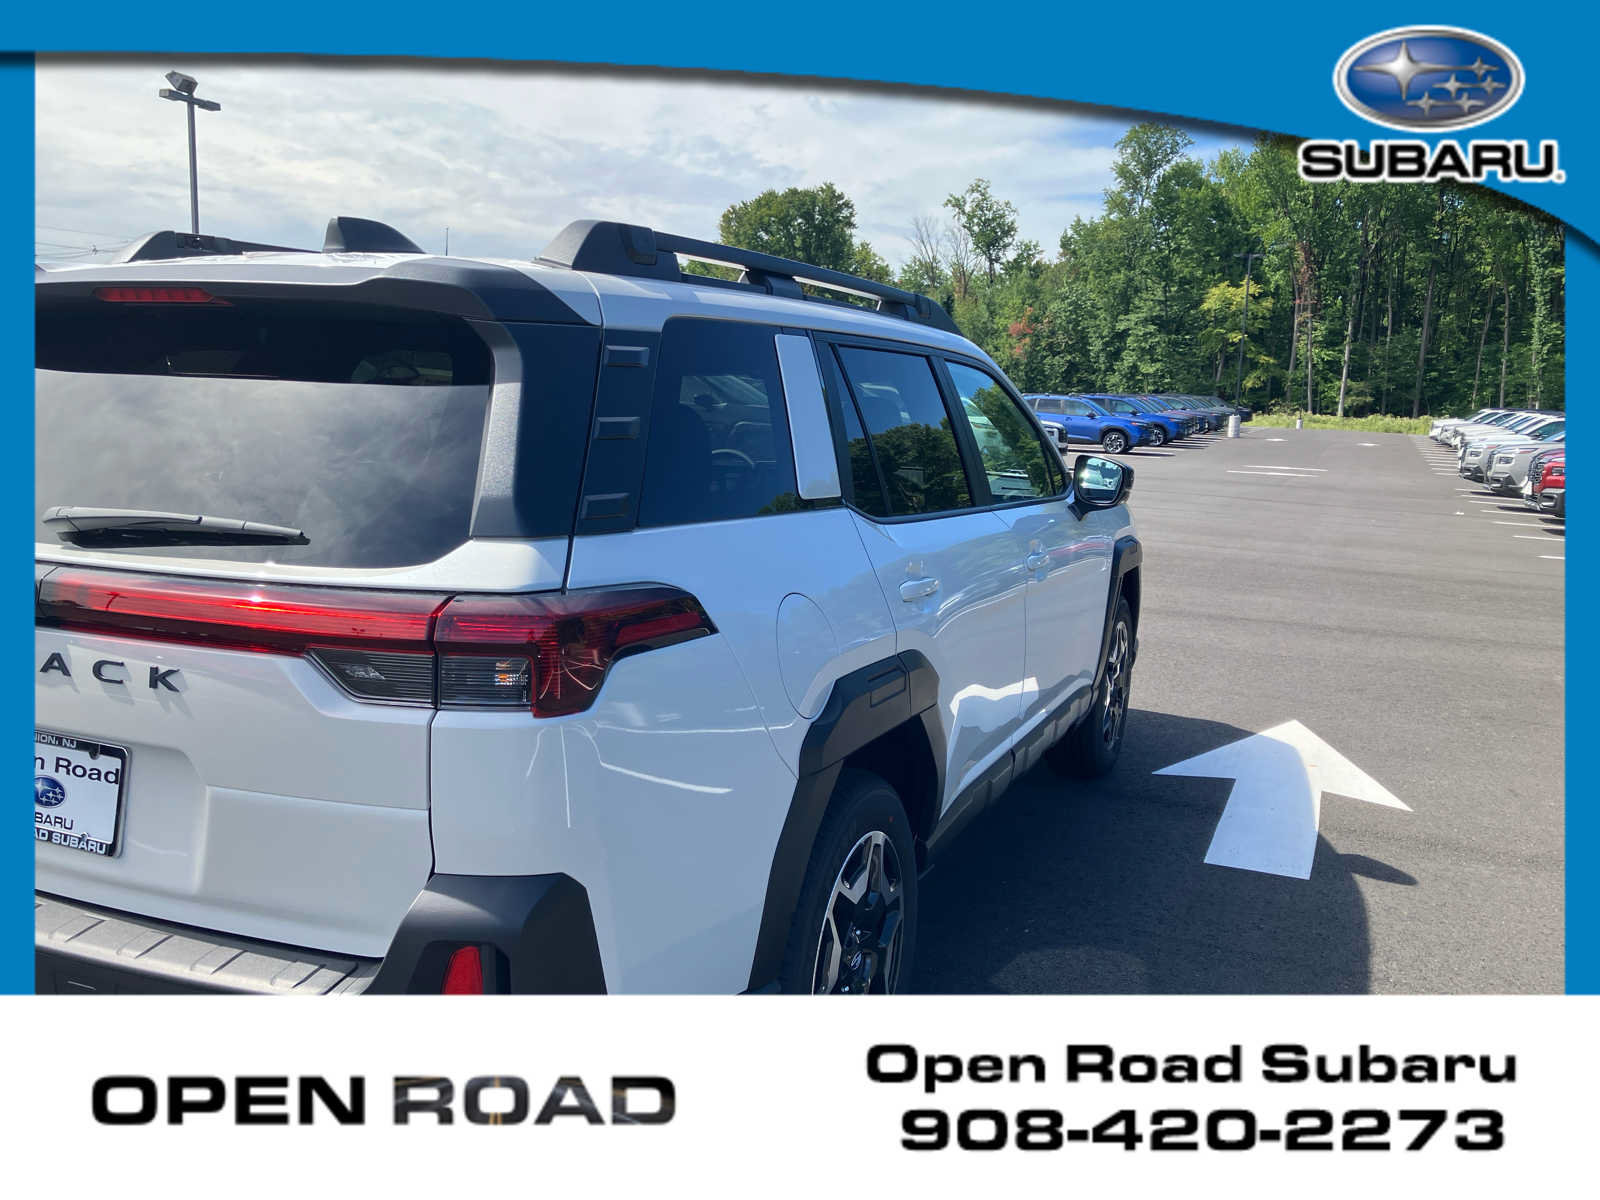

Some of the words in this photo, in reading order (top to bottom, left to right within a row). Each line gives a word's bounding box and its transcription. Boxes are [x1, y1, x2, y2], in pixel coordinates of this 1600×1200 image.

[39, 652, 181, 693] ACK
[62, 739, 77, 749] NJ
[54, 756, 120, 785] Road
[51, 832, 107, 855] SUBARU
